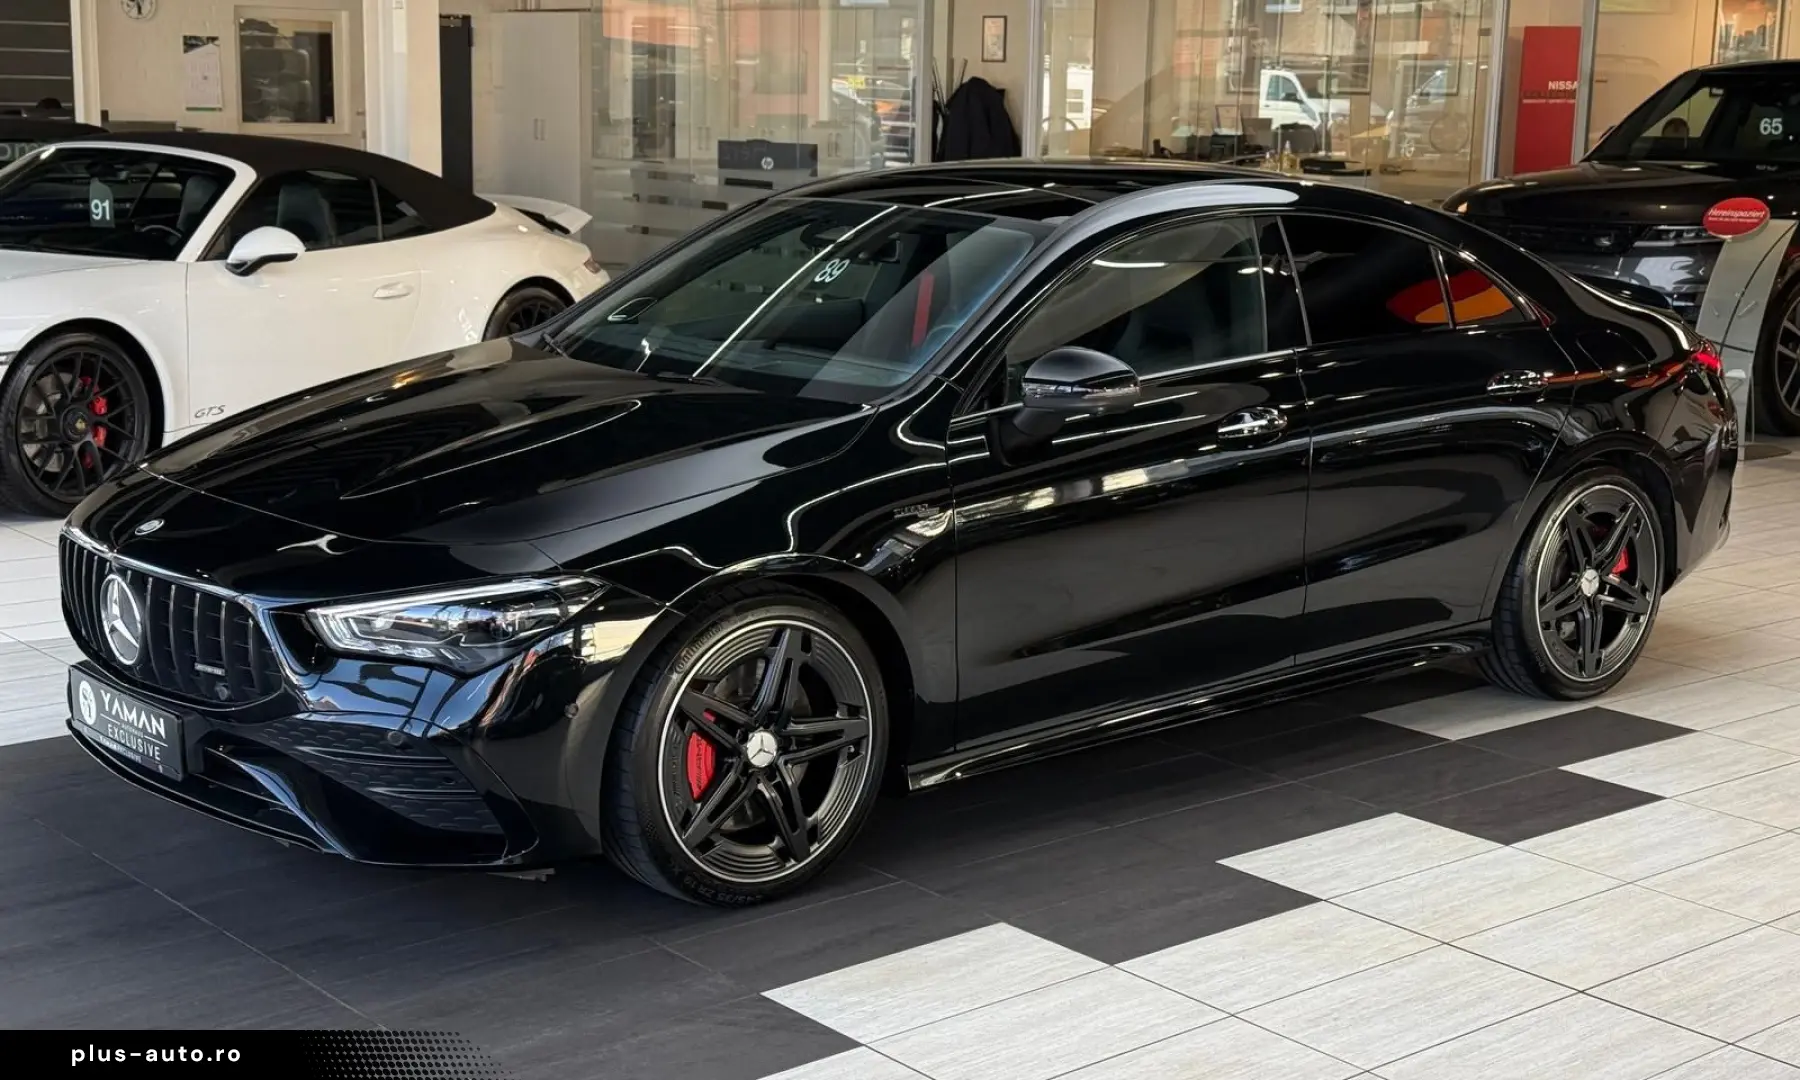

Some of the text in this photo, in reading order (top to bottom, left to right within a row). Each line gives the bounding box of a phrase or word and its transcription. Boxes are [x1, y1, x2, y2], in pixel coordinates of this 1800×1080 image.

[1759, 117, 1783, 135] 65
[91, 199, 110, 221] 91
[814, 258, 850, 283] 89
[194, 404, 226, 419] GTS
[100, 689, 166, 739] YAMAN
[107, 723, 161, 761] EXCLUSIVE
